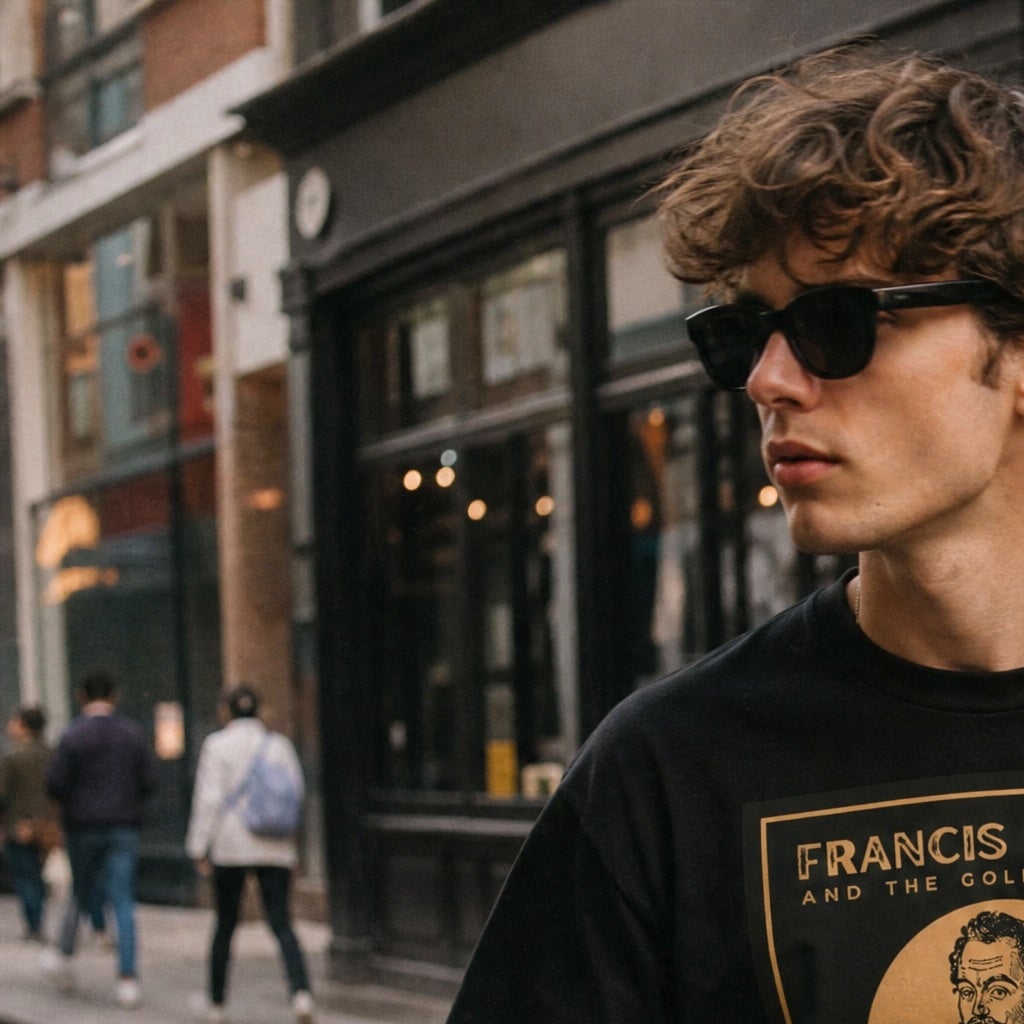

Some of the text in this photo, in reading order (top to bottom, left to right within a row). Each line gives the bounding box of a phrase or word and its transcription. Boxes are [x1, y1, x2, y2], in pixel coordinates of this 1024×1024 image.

[796, 822, 1008, 881] FRANCIS
[802, 884, 862, 905] AND
[885, 875, 938, 896] THE
